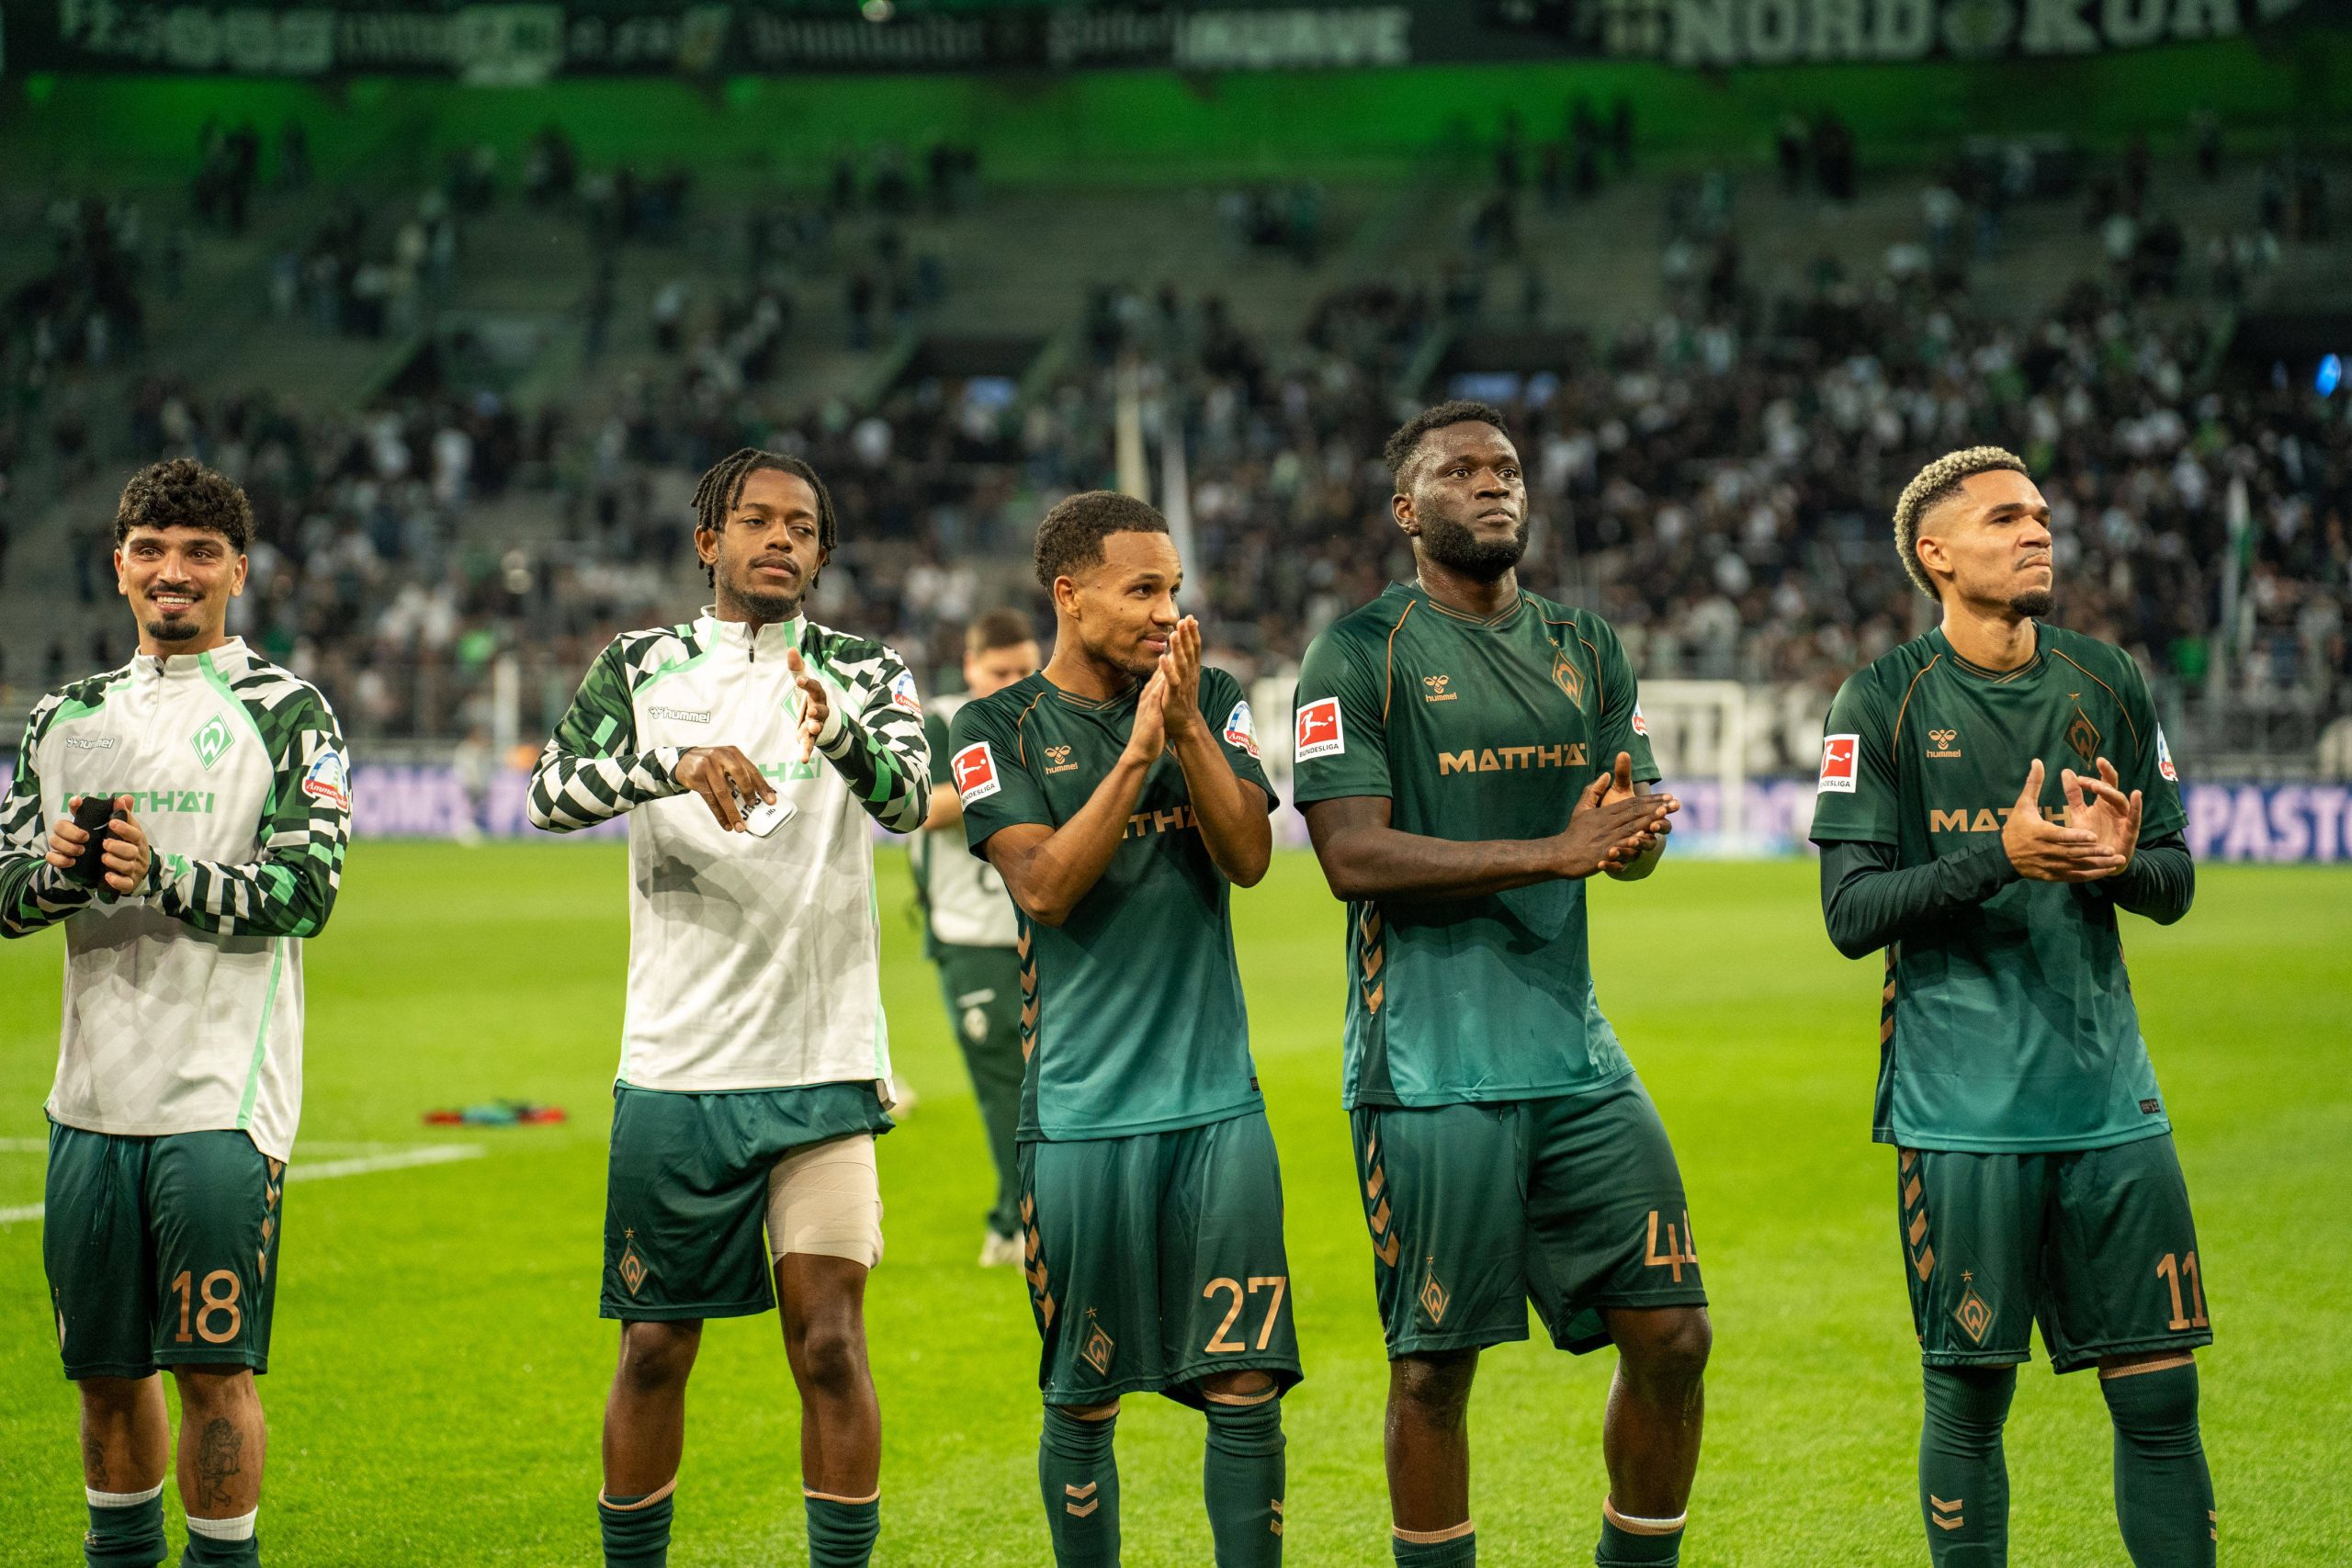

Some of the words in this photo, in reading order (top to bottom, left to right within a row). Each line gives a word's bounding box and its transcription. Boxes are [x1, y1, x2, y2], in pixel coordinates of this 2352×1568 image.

[2021, 0, 2292, 55] KUR
[1425, 692, 1458, 703] hummel
[662, 706, 711, 724] hummel
[1299, 743, 1340, 757] BUNDESLIGA
[1439, 743, 1589, 775] MATTHÄ
[1926, 749, 1962, 758] hummel
[1046, 761, 1079, 774] hummel
[2188, 784, 2352, 863] PAST
[172, 1269, 241, 1343] 18
[2156, 1251, 2209, 1330] 11
[1204, 1277, 1286, 1352] 27
